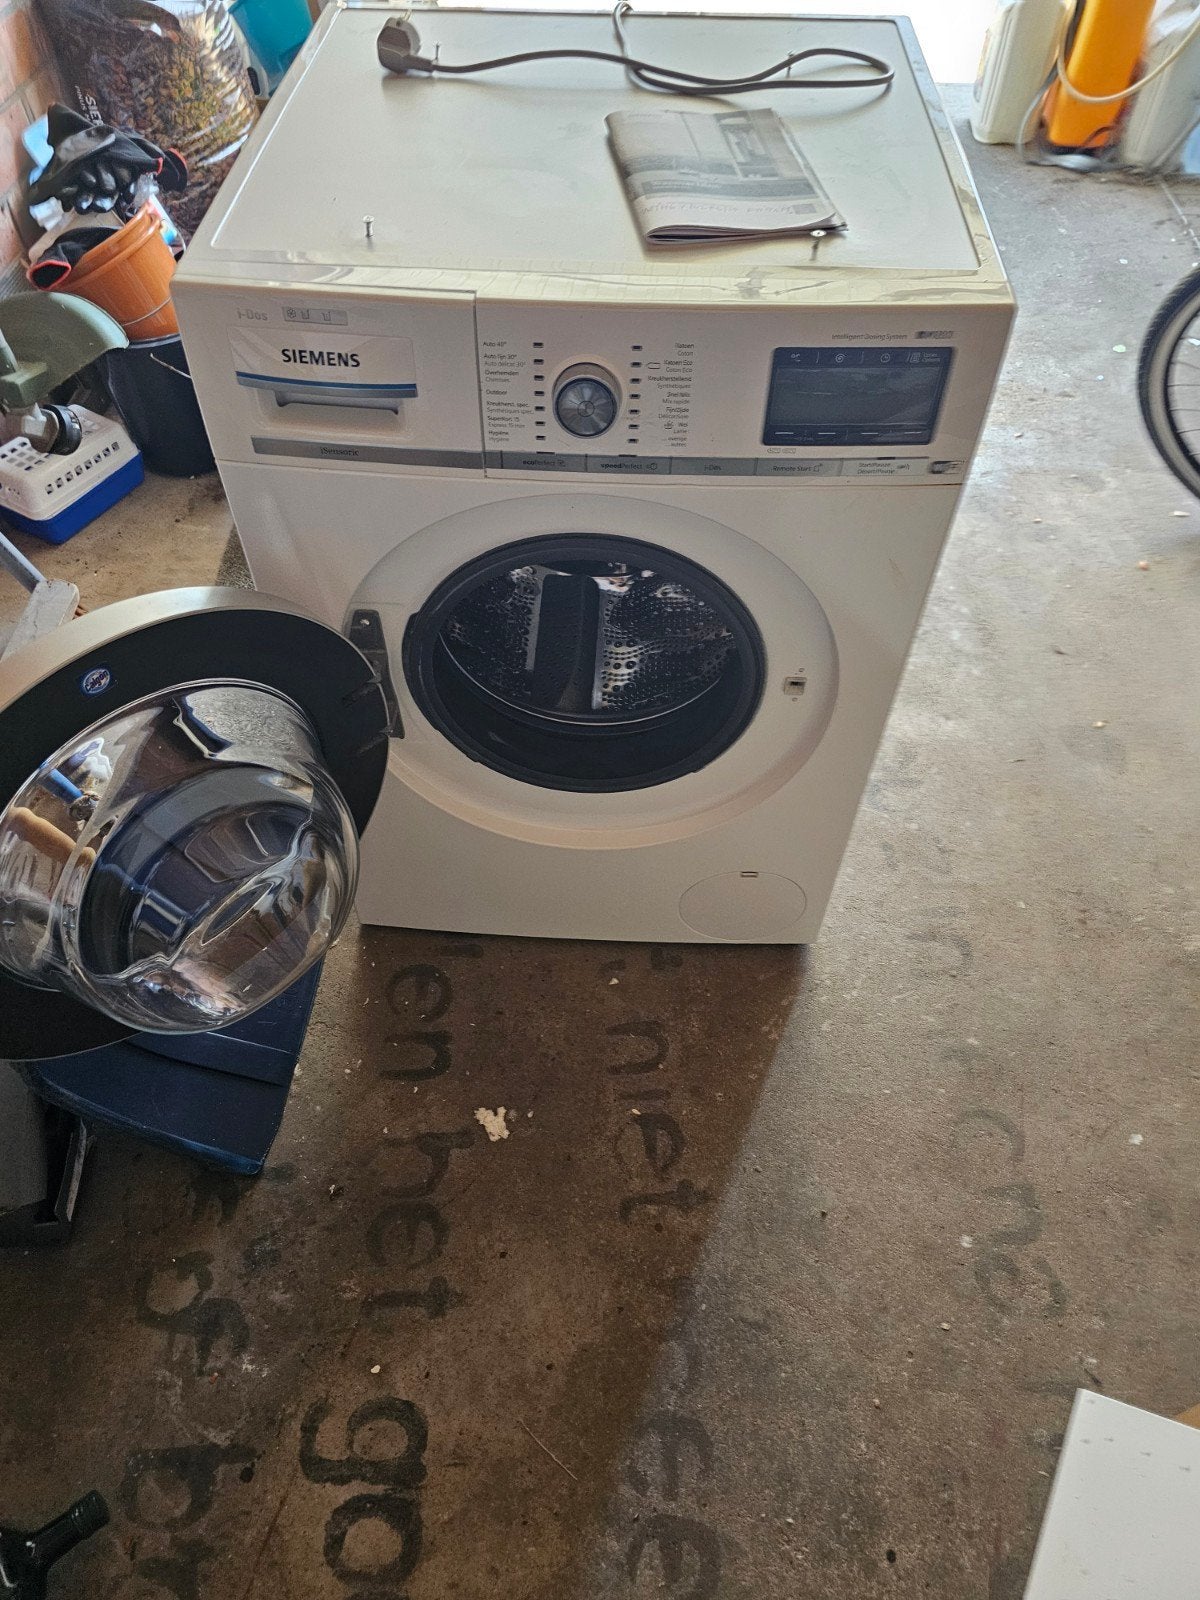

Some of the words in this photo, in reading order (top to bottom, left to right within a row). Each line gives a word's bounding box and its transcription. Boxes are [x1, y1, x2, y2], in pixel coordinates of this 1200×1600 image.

[236, 308, 268, 321] i-Dos
[831, 333, 864, 341] Intelligent
[886, 333, 908, 341] System
[281, 348, 361, 368] SIEMENS
[600, 462, 643, 470] speedPerfect
[772, 464, 796, 472] Remote
[797, 464, 812, 473] Start
[84, 670, 109, 692] Calgon
[361, 1133, 474, 1318] het
